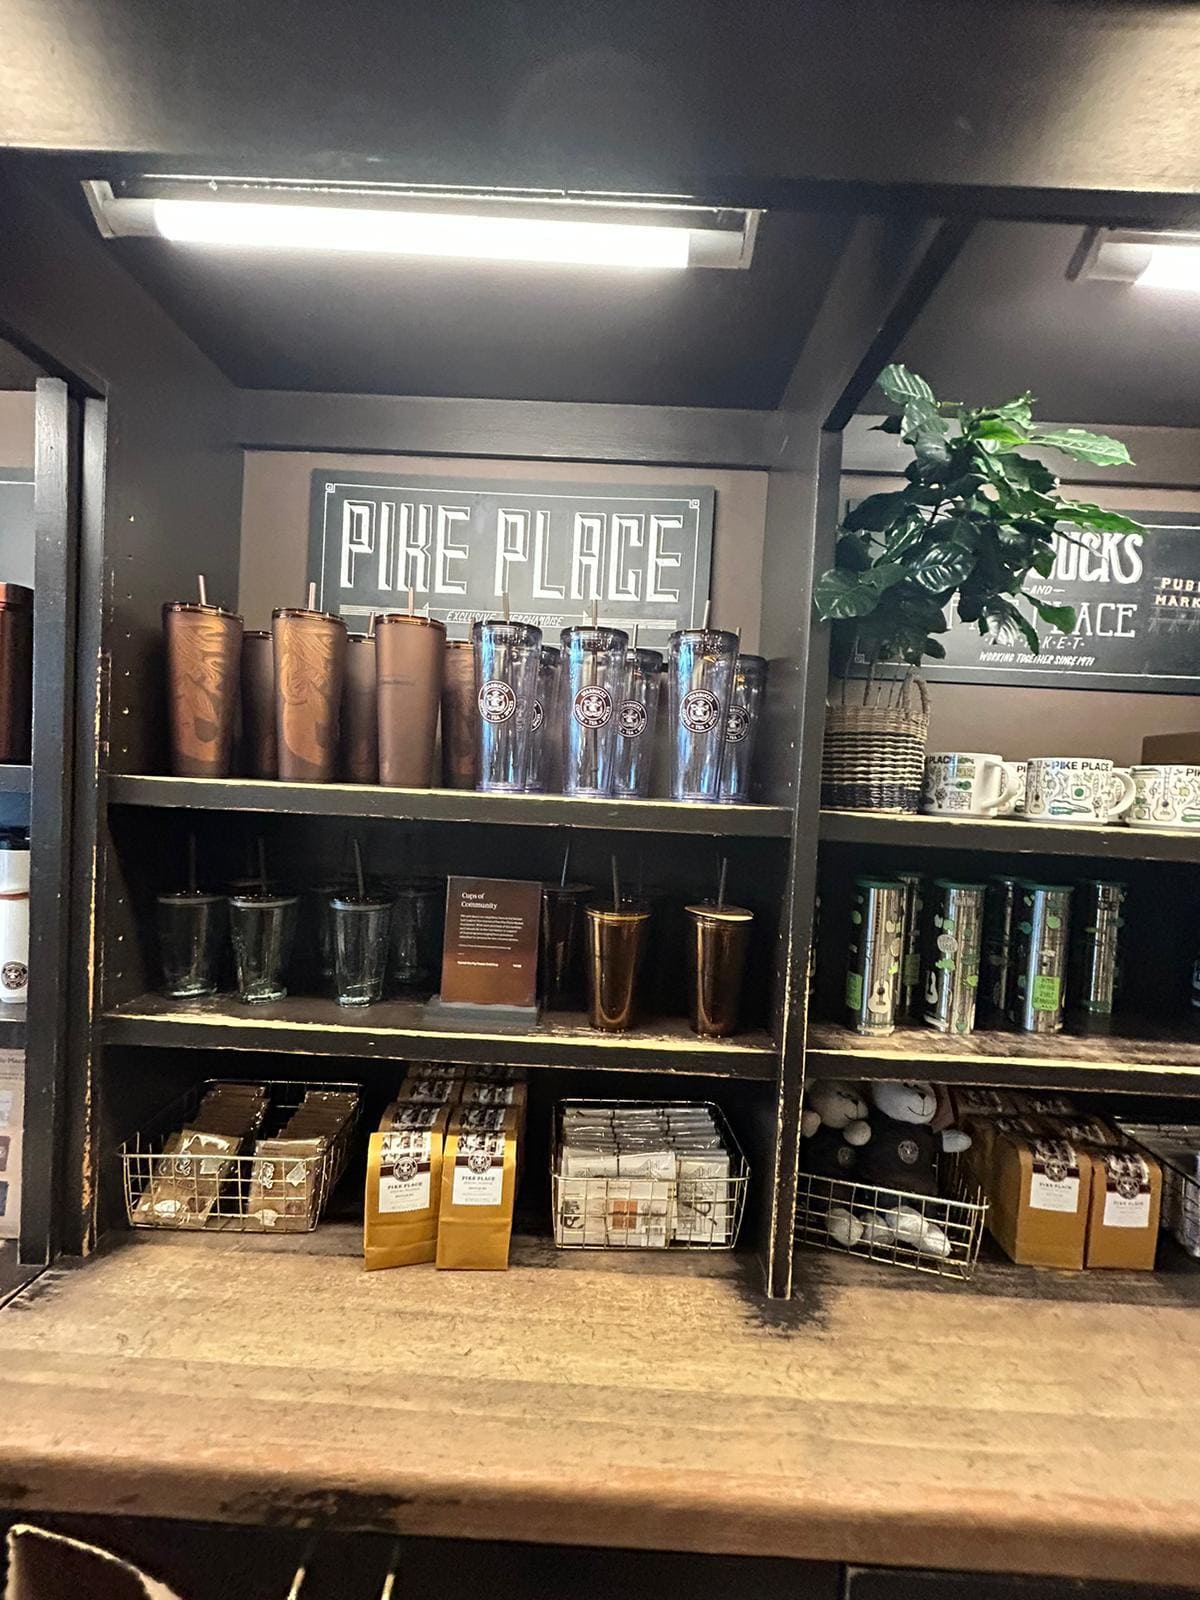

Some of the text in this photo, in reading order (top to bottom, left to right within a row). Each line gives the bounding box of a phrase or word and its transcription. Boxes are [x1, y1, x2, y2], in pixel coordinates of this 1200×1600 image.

[340, 499, 683, 602] PIKE PLACE
[1030, 585, 1053, 595] AND
[446, 610, 497, 625] EXCLUSIVE
[979, 651, 1096, 667] WORKING TOGETHER SINCE 1971
[1051, 760, 1109, 771] PIKE PLACE
[461, 891, 486, 900] Cups of
[461, 901, 498, 911] Community
